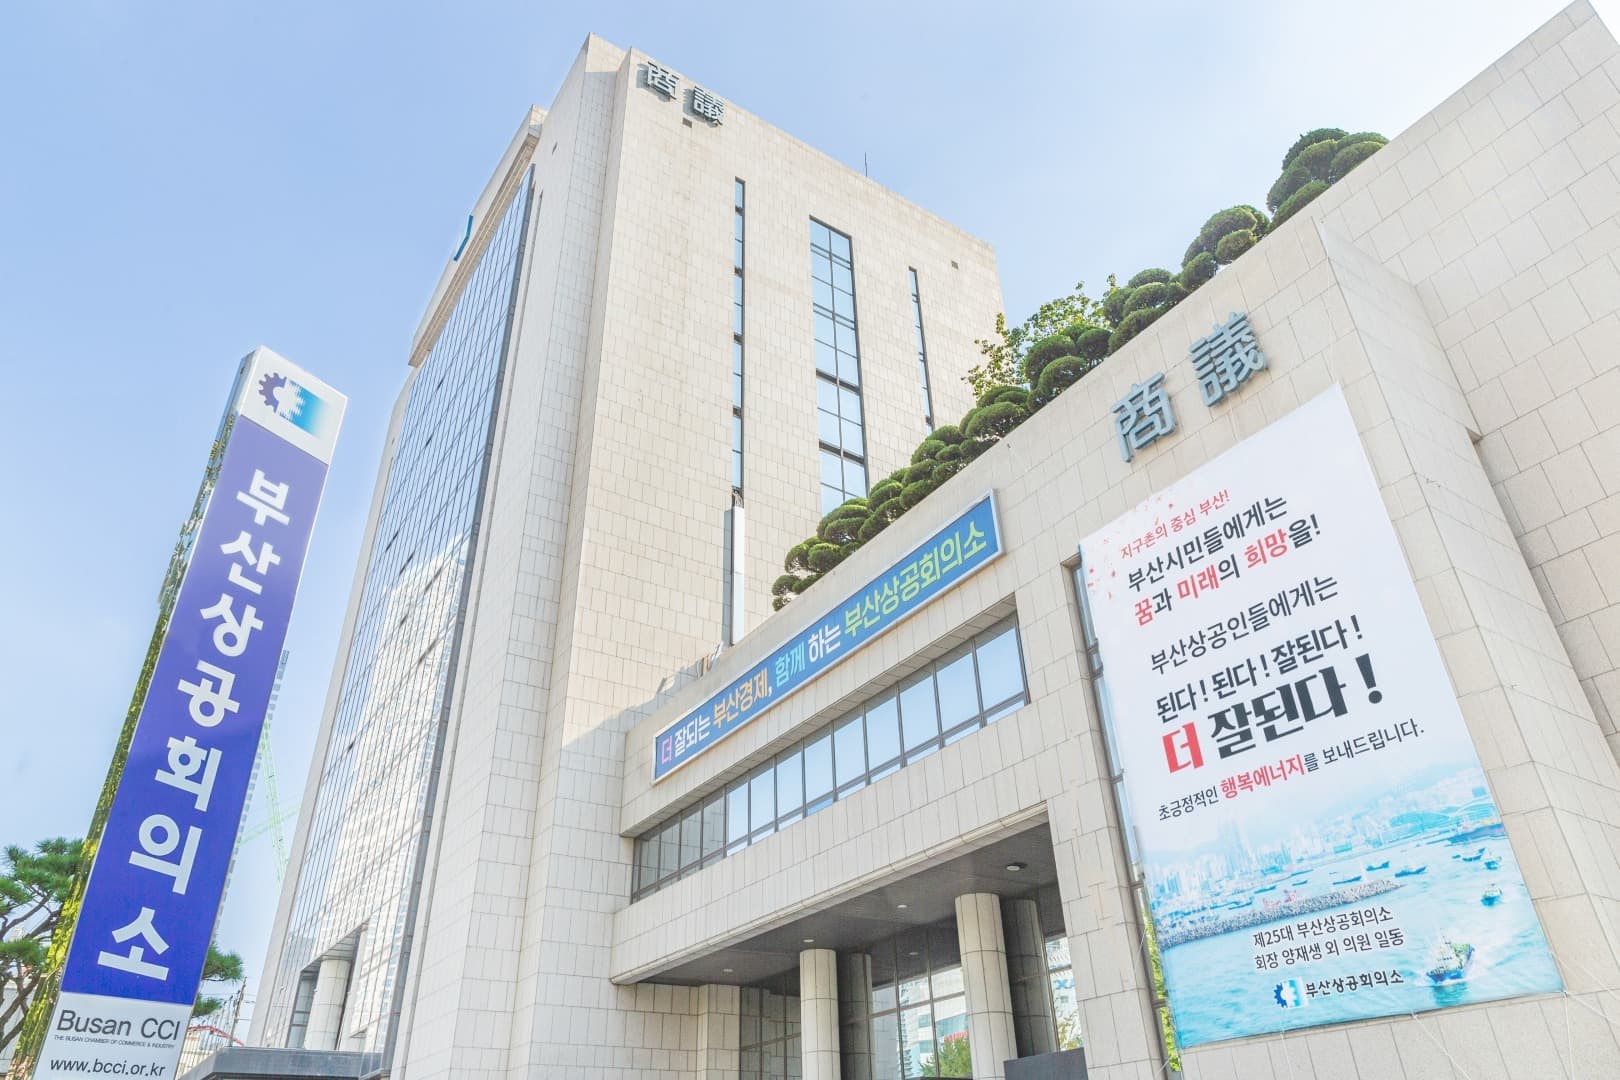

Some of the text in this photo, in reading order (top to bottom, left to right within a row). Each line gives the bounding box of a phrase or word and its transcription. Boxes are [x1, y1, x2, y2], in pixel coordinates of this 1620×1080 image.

[647, 61, 723, 125] 商議
[1111, 311, 1266, 462] 商議
[1121, 489, 1231, 560] 지구촌의 중심 부산!
[1128, 496, 1287, 593] 부산시민들에게는
[1134, 514, 1321, 626] 꿈과 미래의 희망을!
[661, 520, 987, 765] 더 잘되는 부산경제, 함께 하는 부산상공회의소
[1150, 574, 1338, 675] 부산상공인들에게는
[97, 469, 290, 982] 부산상공회의소
[1162, 721, 1204, 774] 더
[1158, 718, 1425, 821] 초긍정적인 행복에너지를 보내드립니다.
[1252, 906, 1394, 949] 제25대 부산상공회의소
[1254, 928, 1405, 971] 회장 양재생 외 의원 일동
[1305, 968, 1405, 999] 부산상공회의소
[56, 1009, 181, 1041] Busan CCI
[50, 1058, 166, 1077] www.bcci.or.kr
